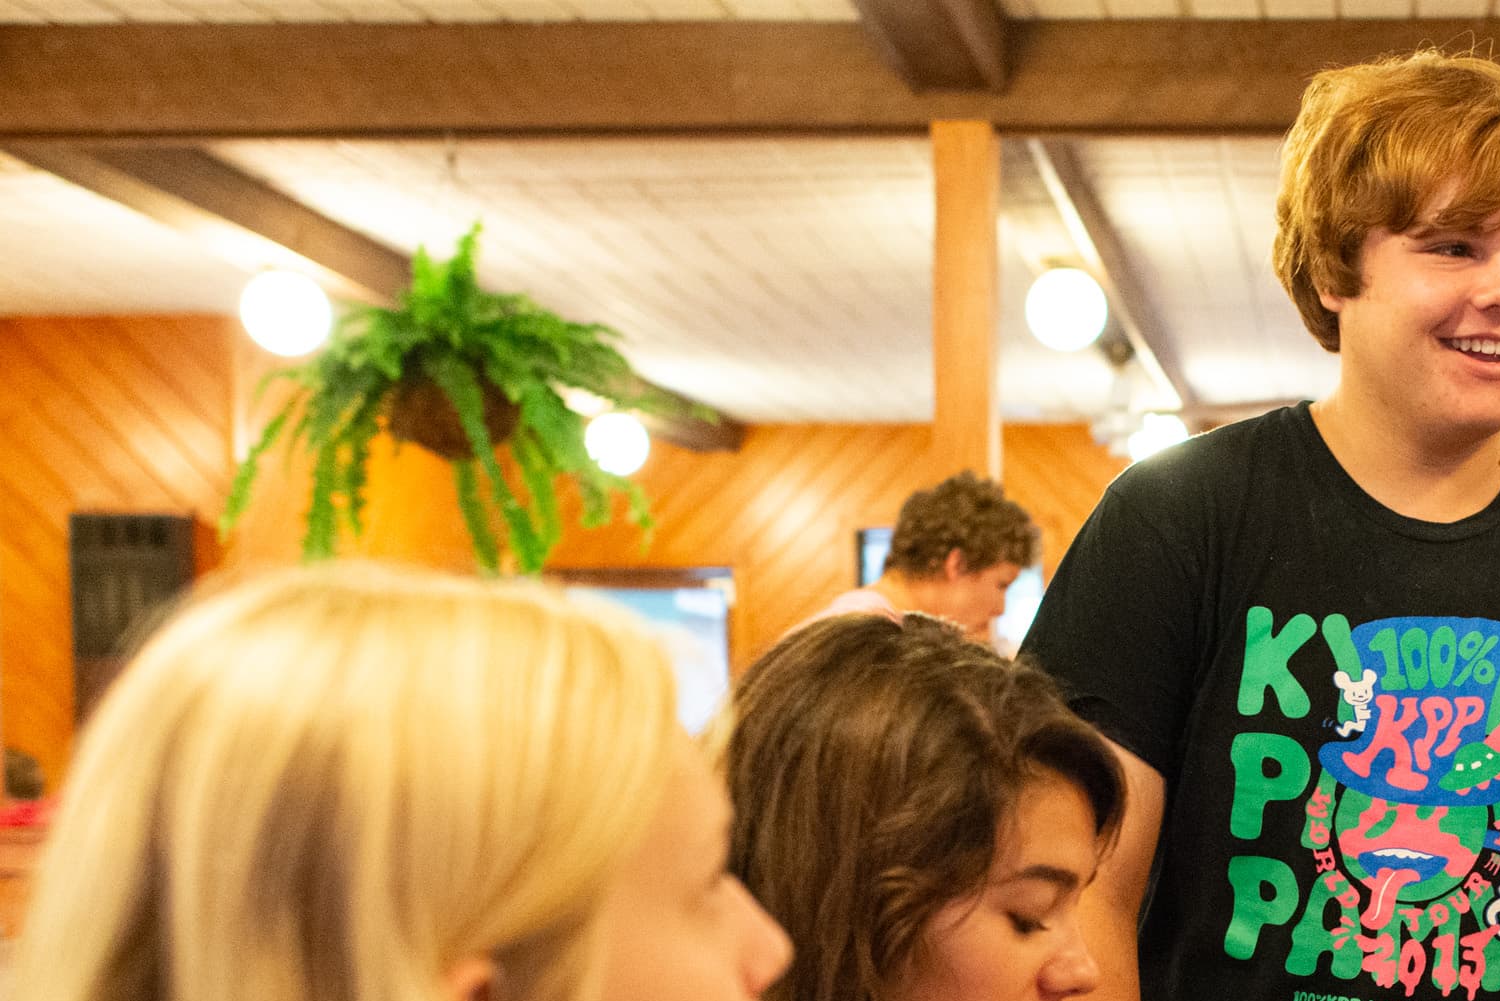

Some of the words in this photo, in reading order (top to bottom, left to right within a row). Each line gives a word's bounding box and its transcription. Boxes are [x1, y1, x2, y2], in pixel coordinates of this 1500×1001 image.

[1369, 626, 1499, 691] 100%
[1342, 694, 1485, 790] KPP
[1306, 786, 1360, 908] WORLD
[1398, 871, 1492, 932] TOUR
[1354, 923, 1500, 1001] 2013
